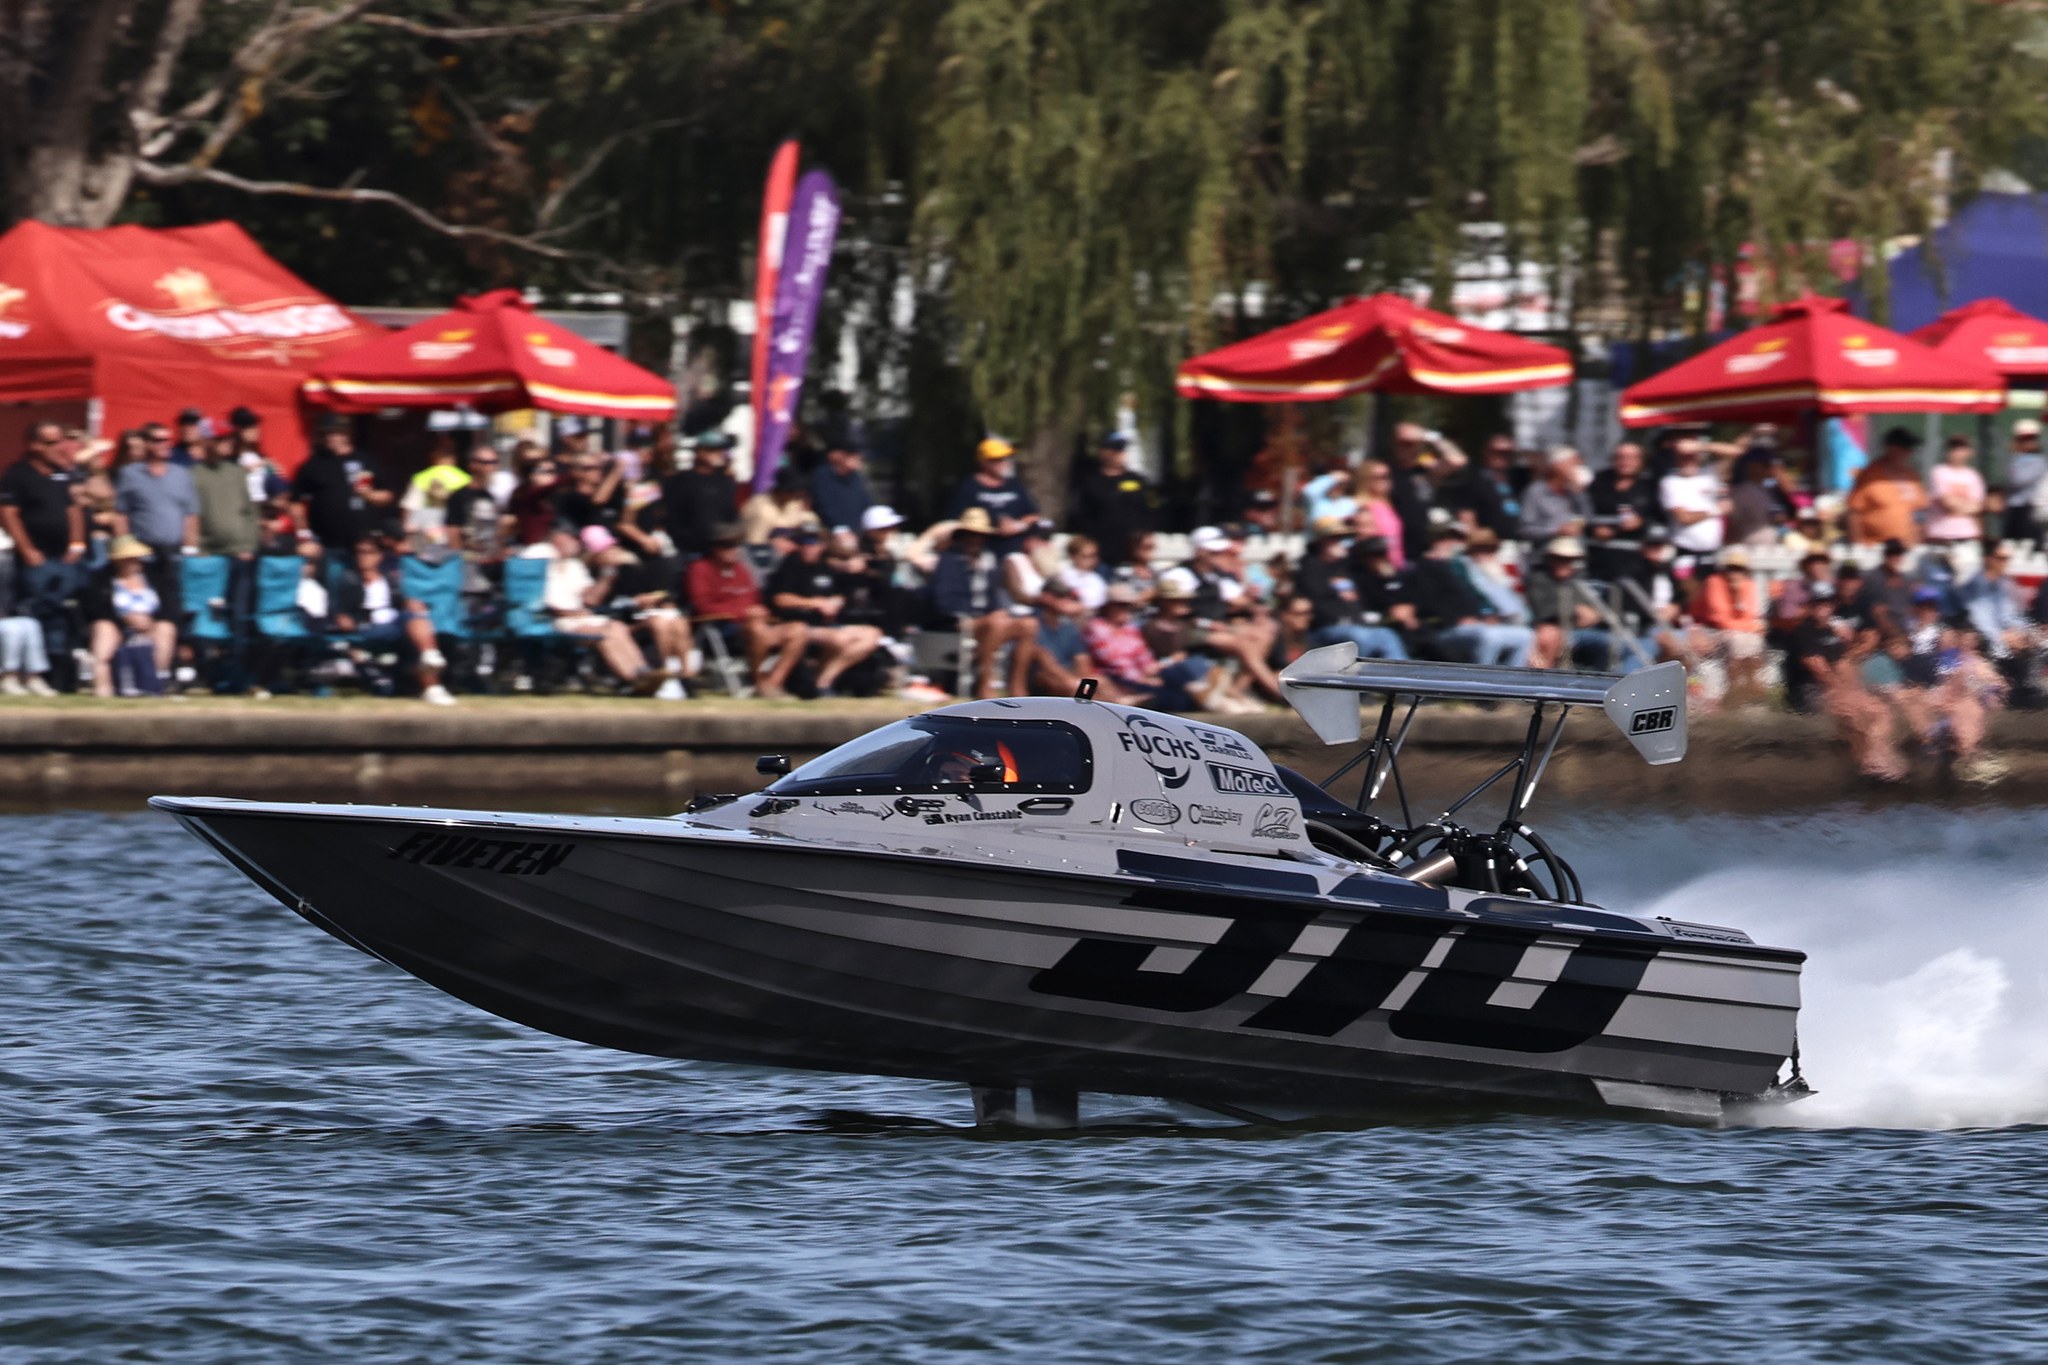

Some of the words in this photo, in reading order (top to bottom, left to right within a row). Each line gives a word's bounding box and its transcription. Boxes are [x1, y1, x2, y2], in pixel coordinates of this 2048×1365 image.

[1632, 710, 1674, 732] CBR
[1117, 732, 1200, 761] FUCHS
[1204, 744, 1254, 761] CARRILLO
[1217, 767, 1281, 793] MoTeC
[944, 813, 972, 823] Ryan
[973, 810, 1023, 820] Constable
[1188, 803, 1243, 826] Childsplay
[387, 832, 577, 875] FIVETEN
